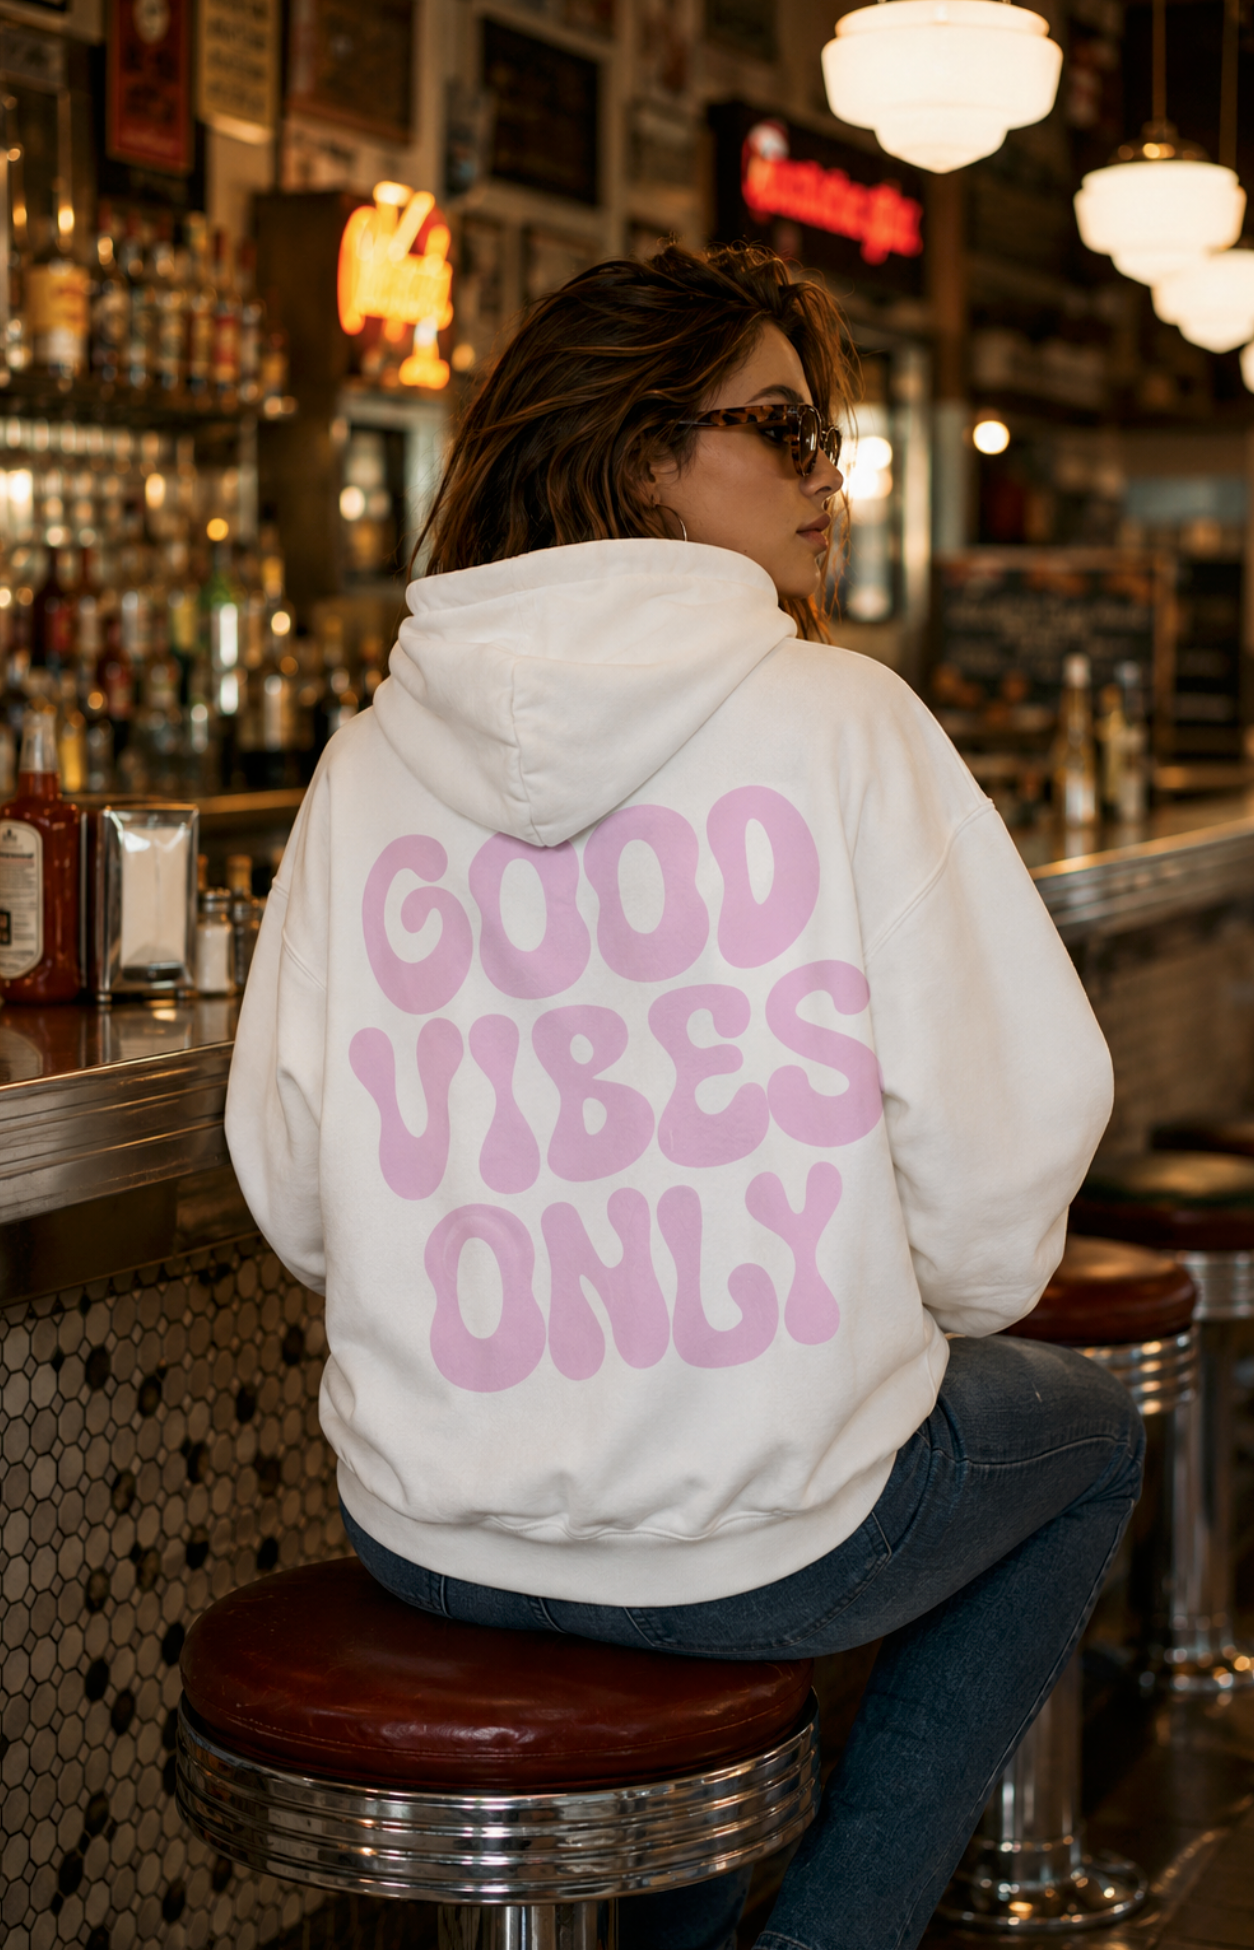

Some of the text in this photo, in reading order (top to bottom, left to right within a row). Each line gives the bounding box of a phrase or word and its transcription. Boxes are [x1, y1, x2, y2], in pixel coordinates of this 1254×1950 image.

[362, 785, 820, 1015] GOOD
[349, 959, 884, 1201] VIBES
[424, 1161, 843, 1393] ONLY
